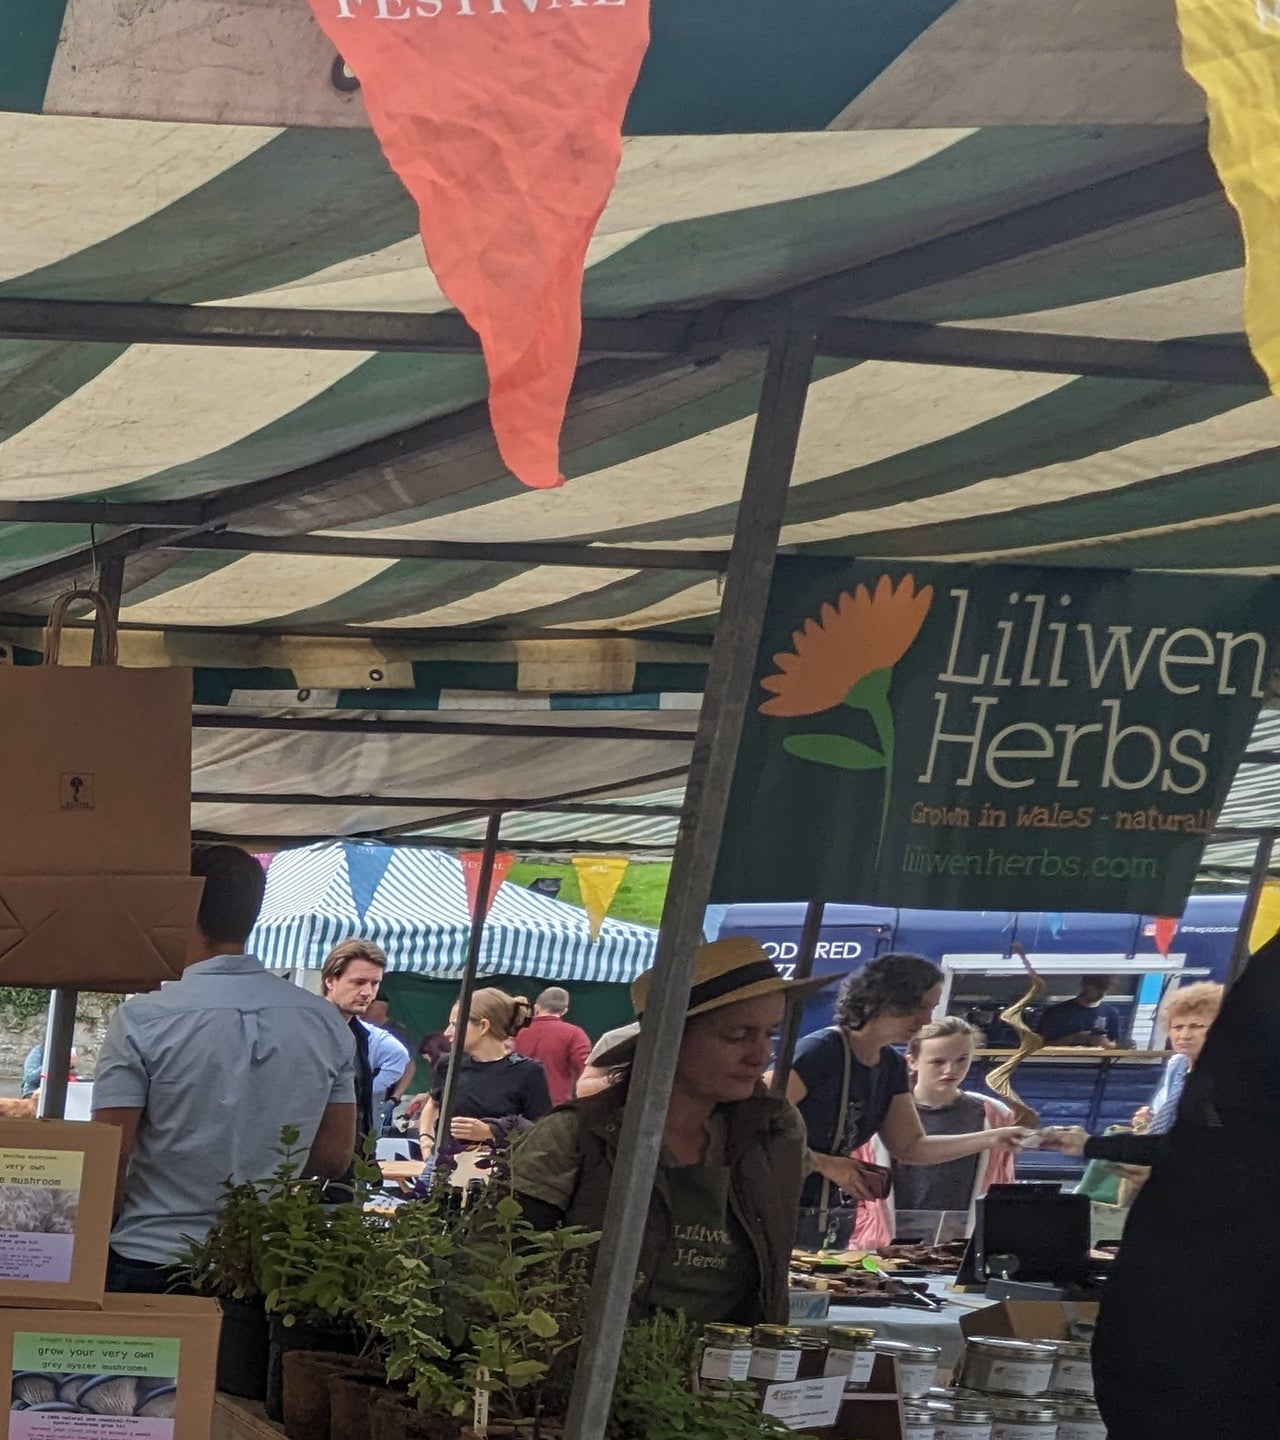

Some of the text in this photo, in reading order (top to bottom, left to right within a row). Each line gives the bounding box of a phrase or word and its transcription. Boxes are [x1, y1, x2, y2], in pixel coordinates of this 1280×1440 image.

[938, 589, 1267, 698] Liliwen
[917, 692, 1211, 795] Herbs
[910, 802, 969, 827] Grown
[978, 802, 1007, 827] in
[761, 941, 862, 959] OD RED
[11, 1178, 61, 1186] mushroom
[38, 1347, 63, 1356] grow
[69, 1348, 95, 1357] your
[102, 1350, 128, 1359] very
[42, 1361, 61, 1369] grey
